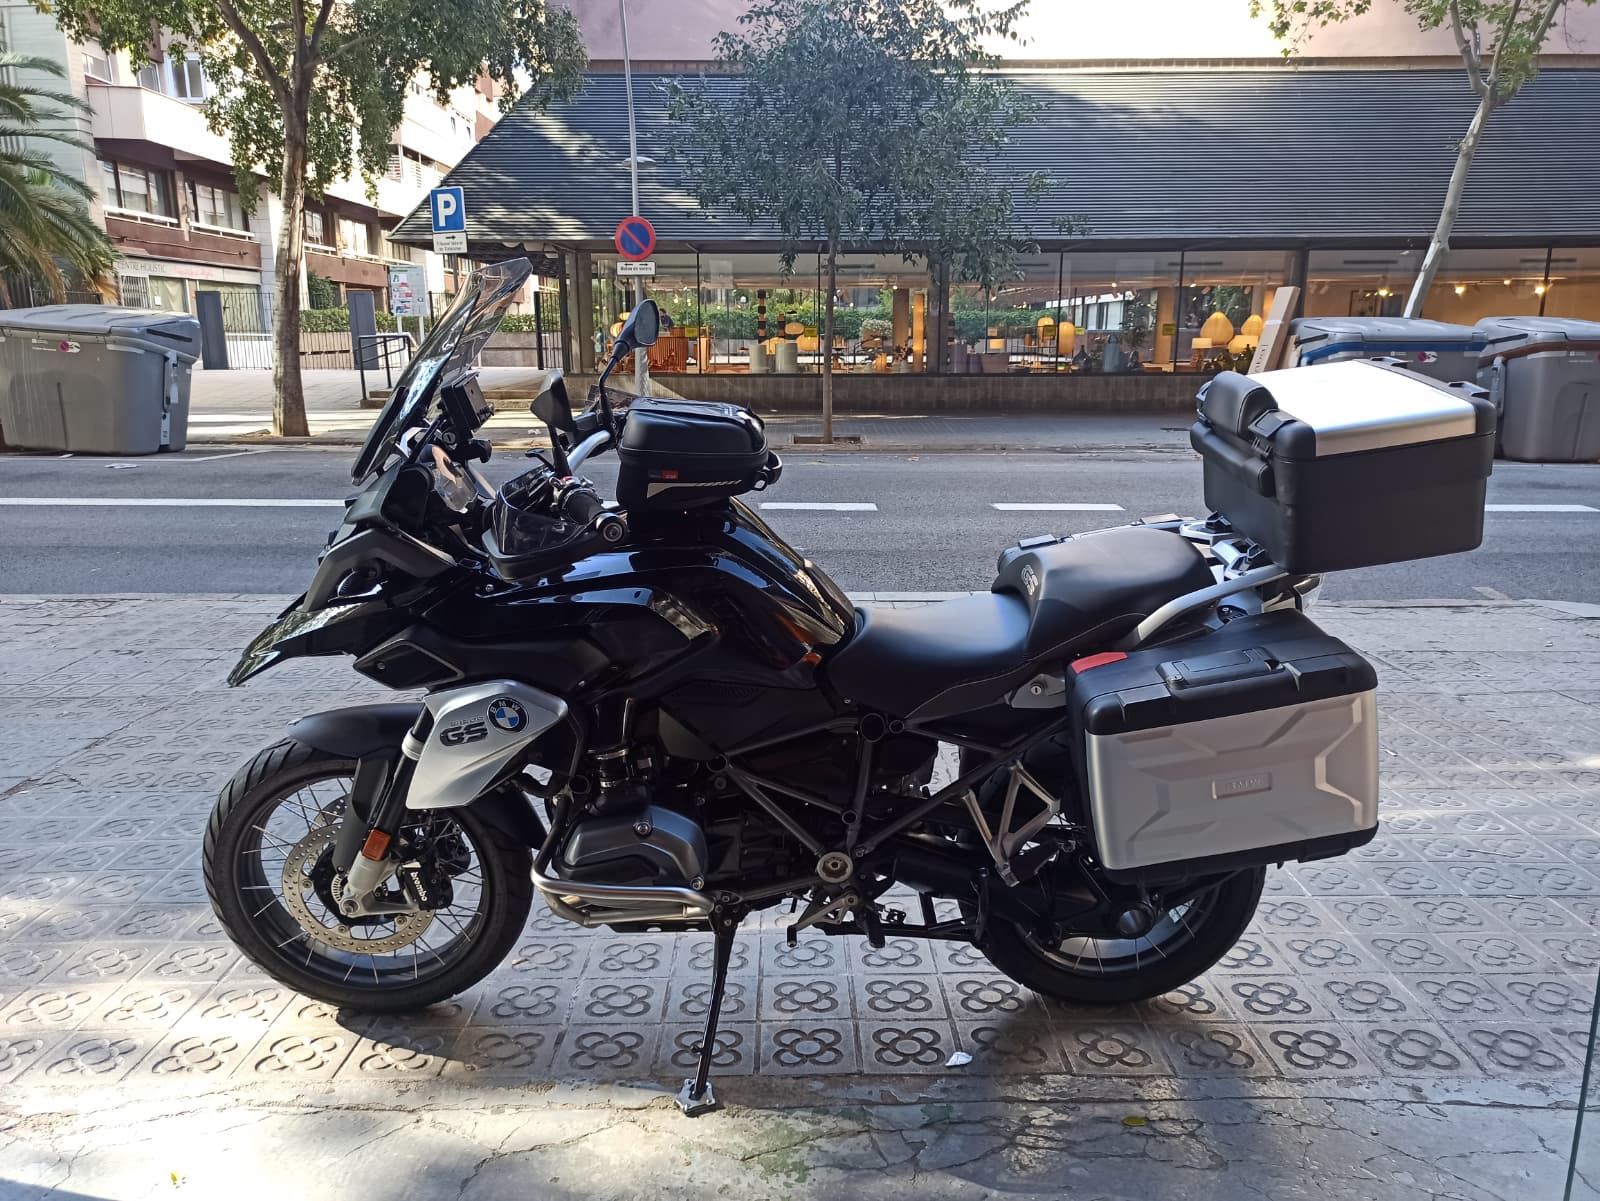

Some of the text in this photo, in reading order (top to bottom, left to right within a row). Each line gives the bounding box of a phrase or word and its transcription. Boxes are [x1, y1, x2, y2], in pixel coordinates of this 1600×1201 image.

[437, 193, 457, 227] P
[490, 700, 521, 715] BMW
[440, 721, 489, 747] GS
[410, 871, 428, 902] brembo
